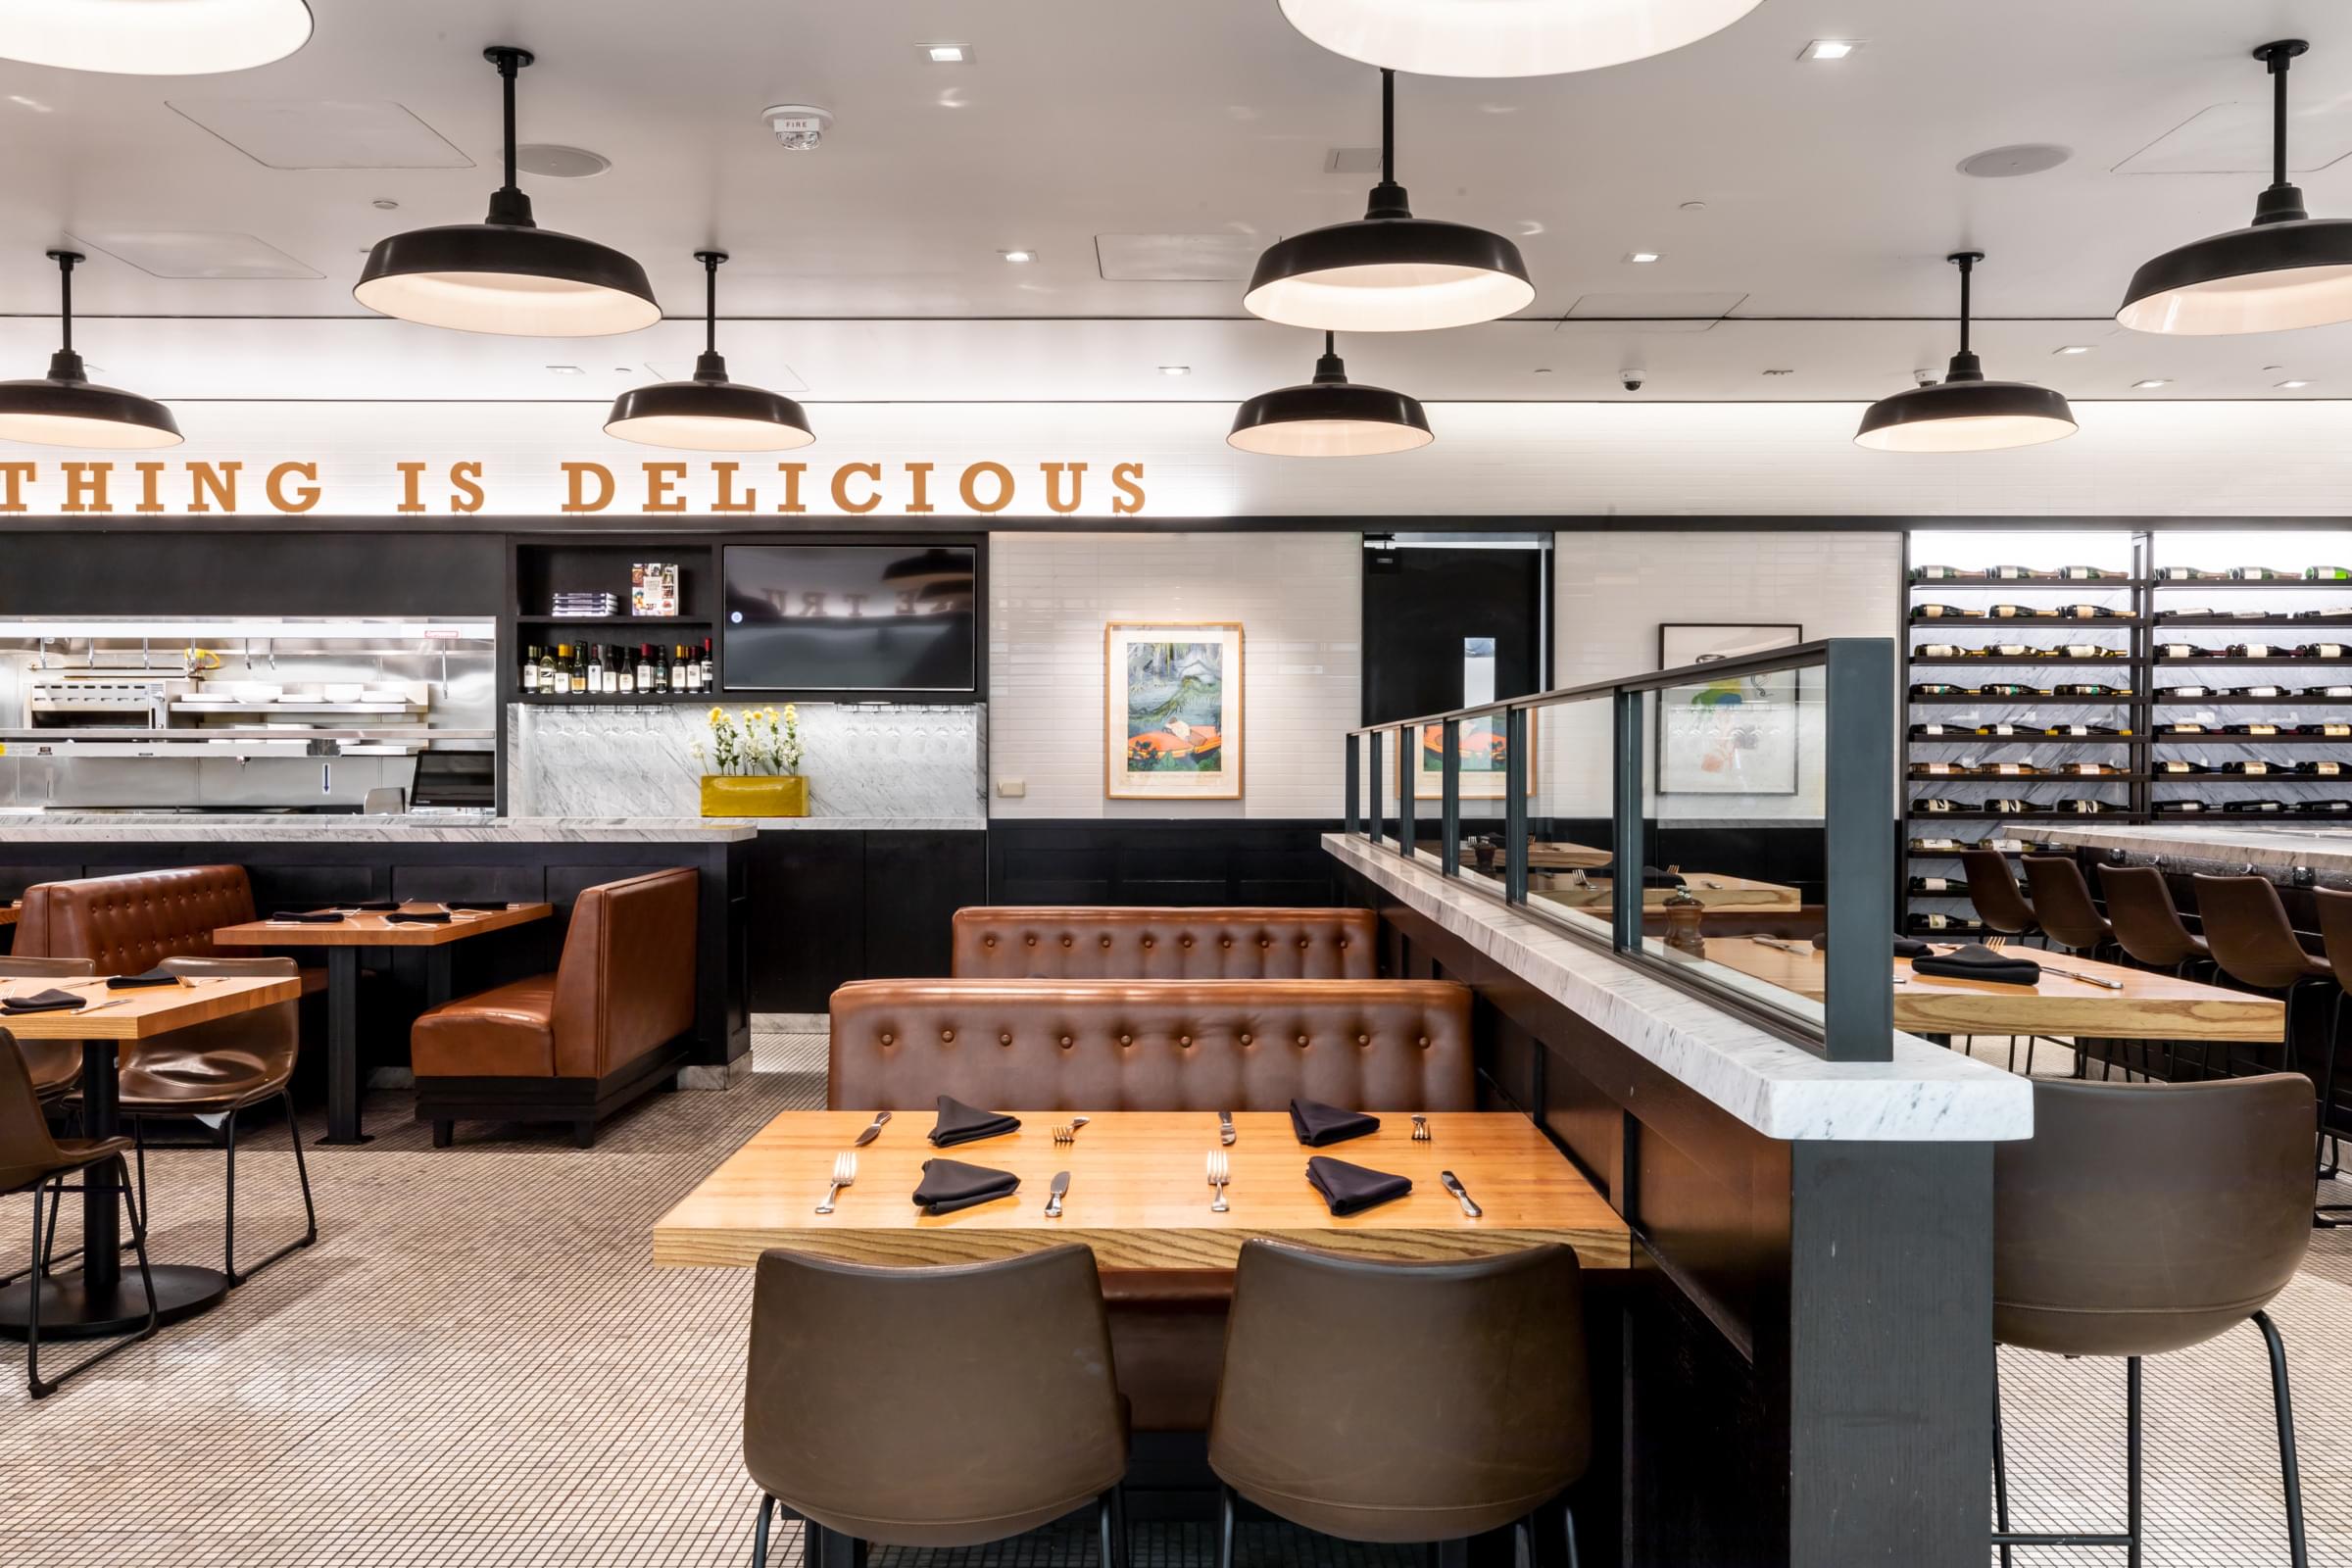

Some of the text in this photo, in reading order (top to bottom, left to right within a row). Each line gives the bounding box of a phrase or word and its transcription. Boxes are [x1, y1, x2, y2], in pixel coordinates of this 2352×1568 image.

[0, 461, 1145, 514] THING IS DELICIOUS
